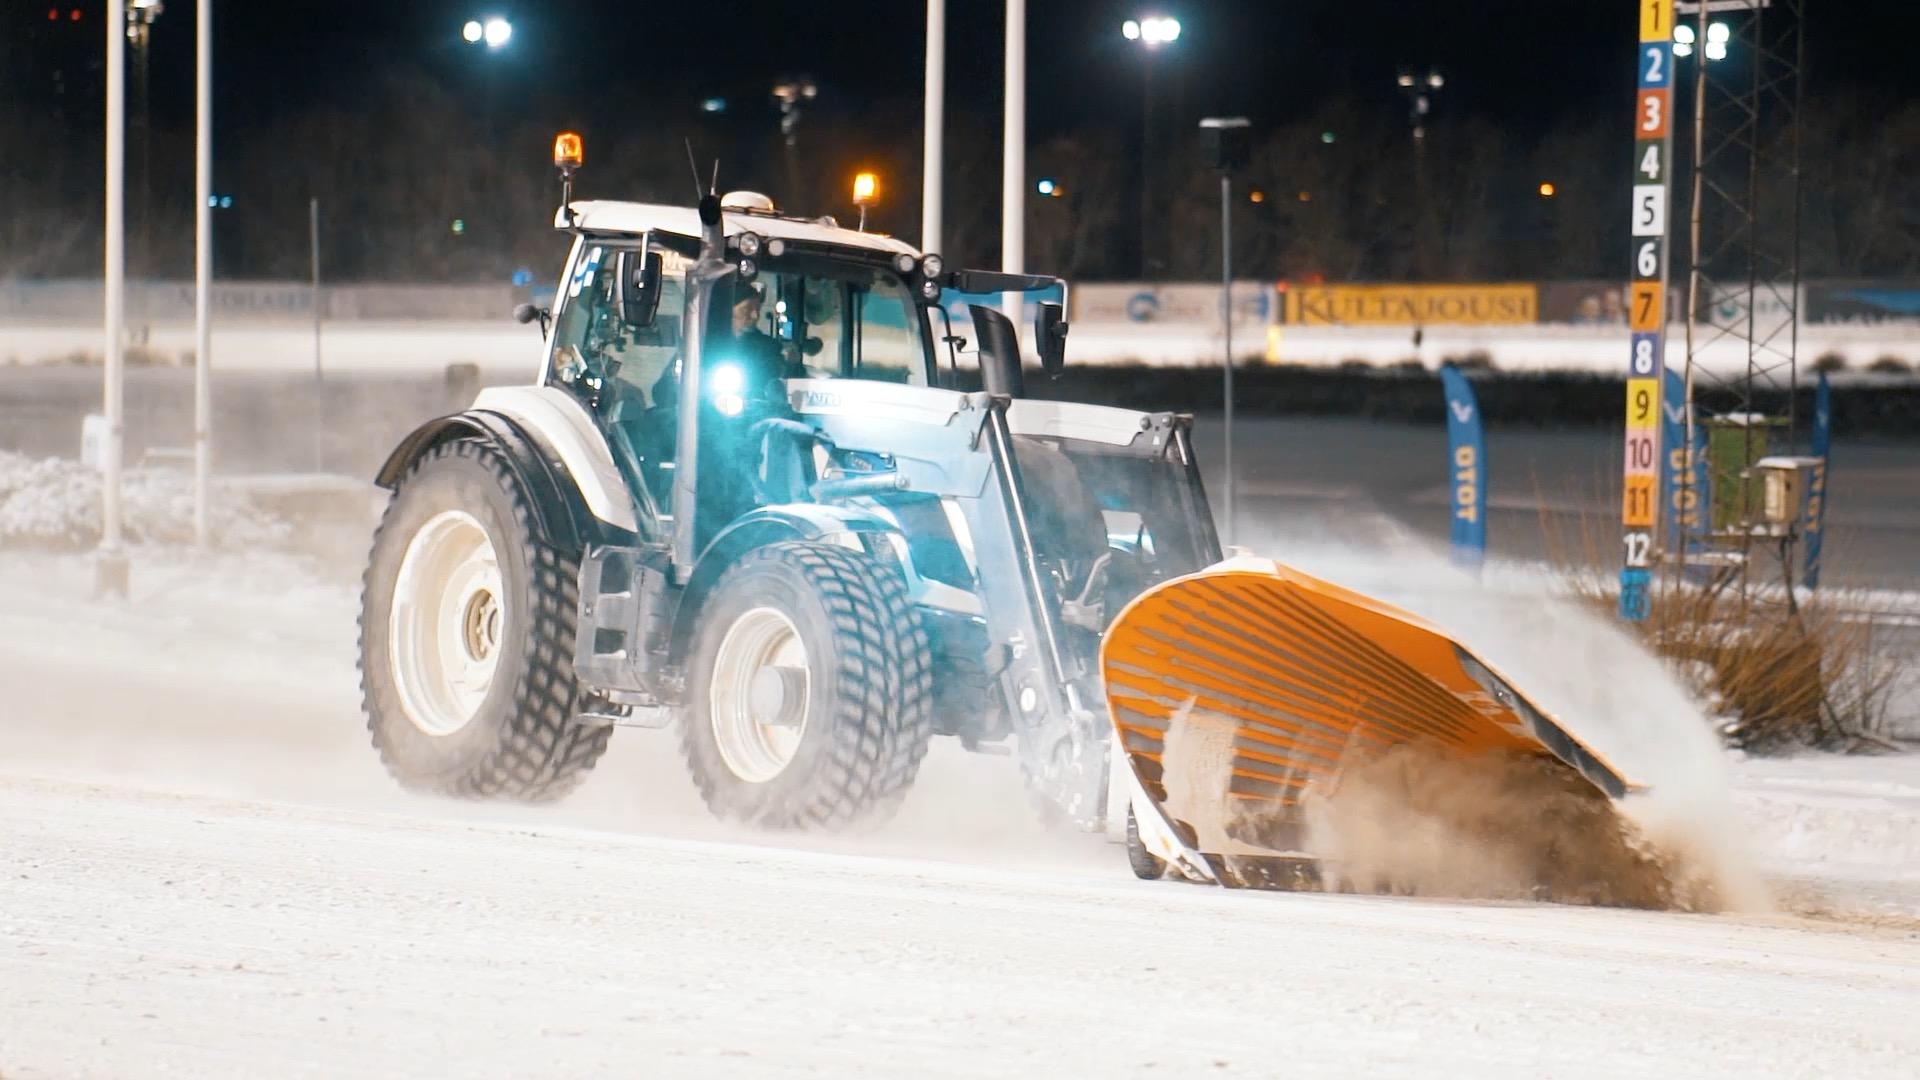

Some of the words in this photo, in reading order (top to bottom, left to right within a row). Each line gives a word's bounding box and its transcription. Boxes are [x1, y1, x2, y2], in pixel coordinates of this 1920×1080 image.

[1650, 1, 1660, 33] 1
[1645, 47, 1662, 82] 2
[1642, 96, 1661, 131] 3
[1640, 145, 1660, 180] 4
[1641, 195, 1655, 226] 5
[1637, 242, 1657, 277] 6
[1296, 291, 1530, 325] KULTAJOUSI
[1638, 292, 1653, 325] 7
[1635, 339, 1653, 374] 8
[1635, 389, 1650, 421] 9
[1629, 438, 1652, 469] 10
[1628, 487, 1650, 518] 11
[1623, 532, 1651, 567] 12
